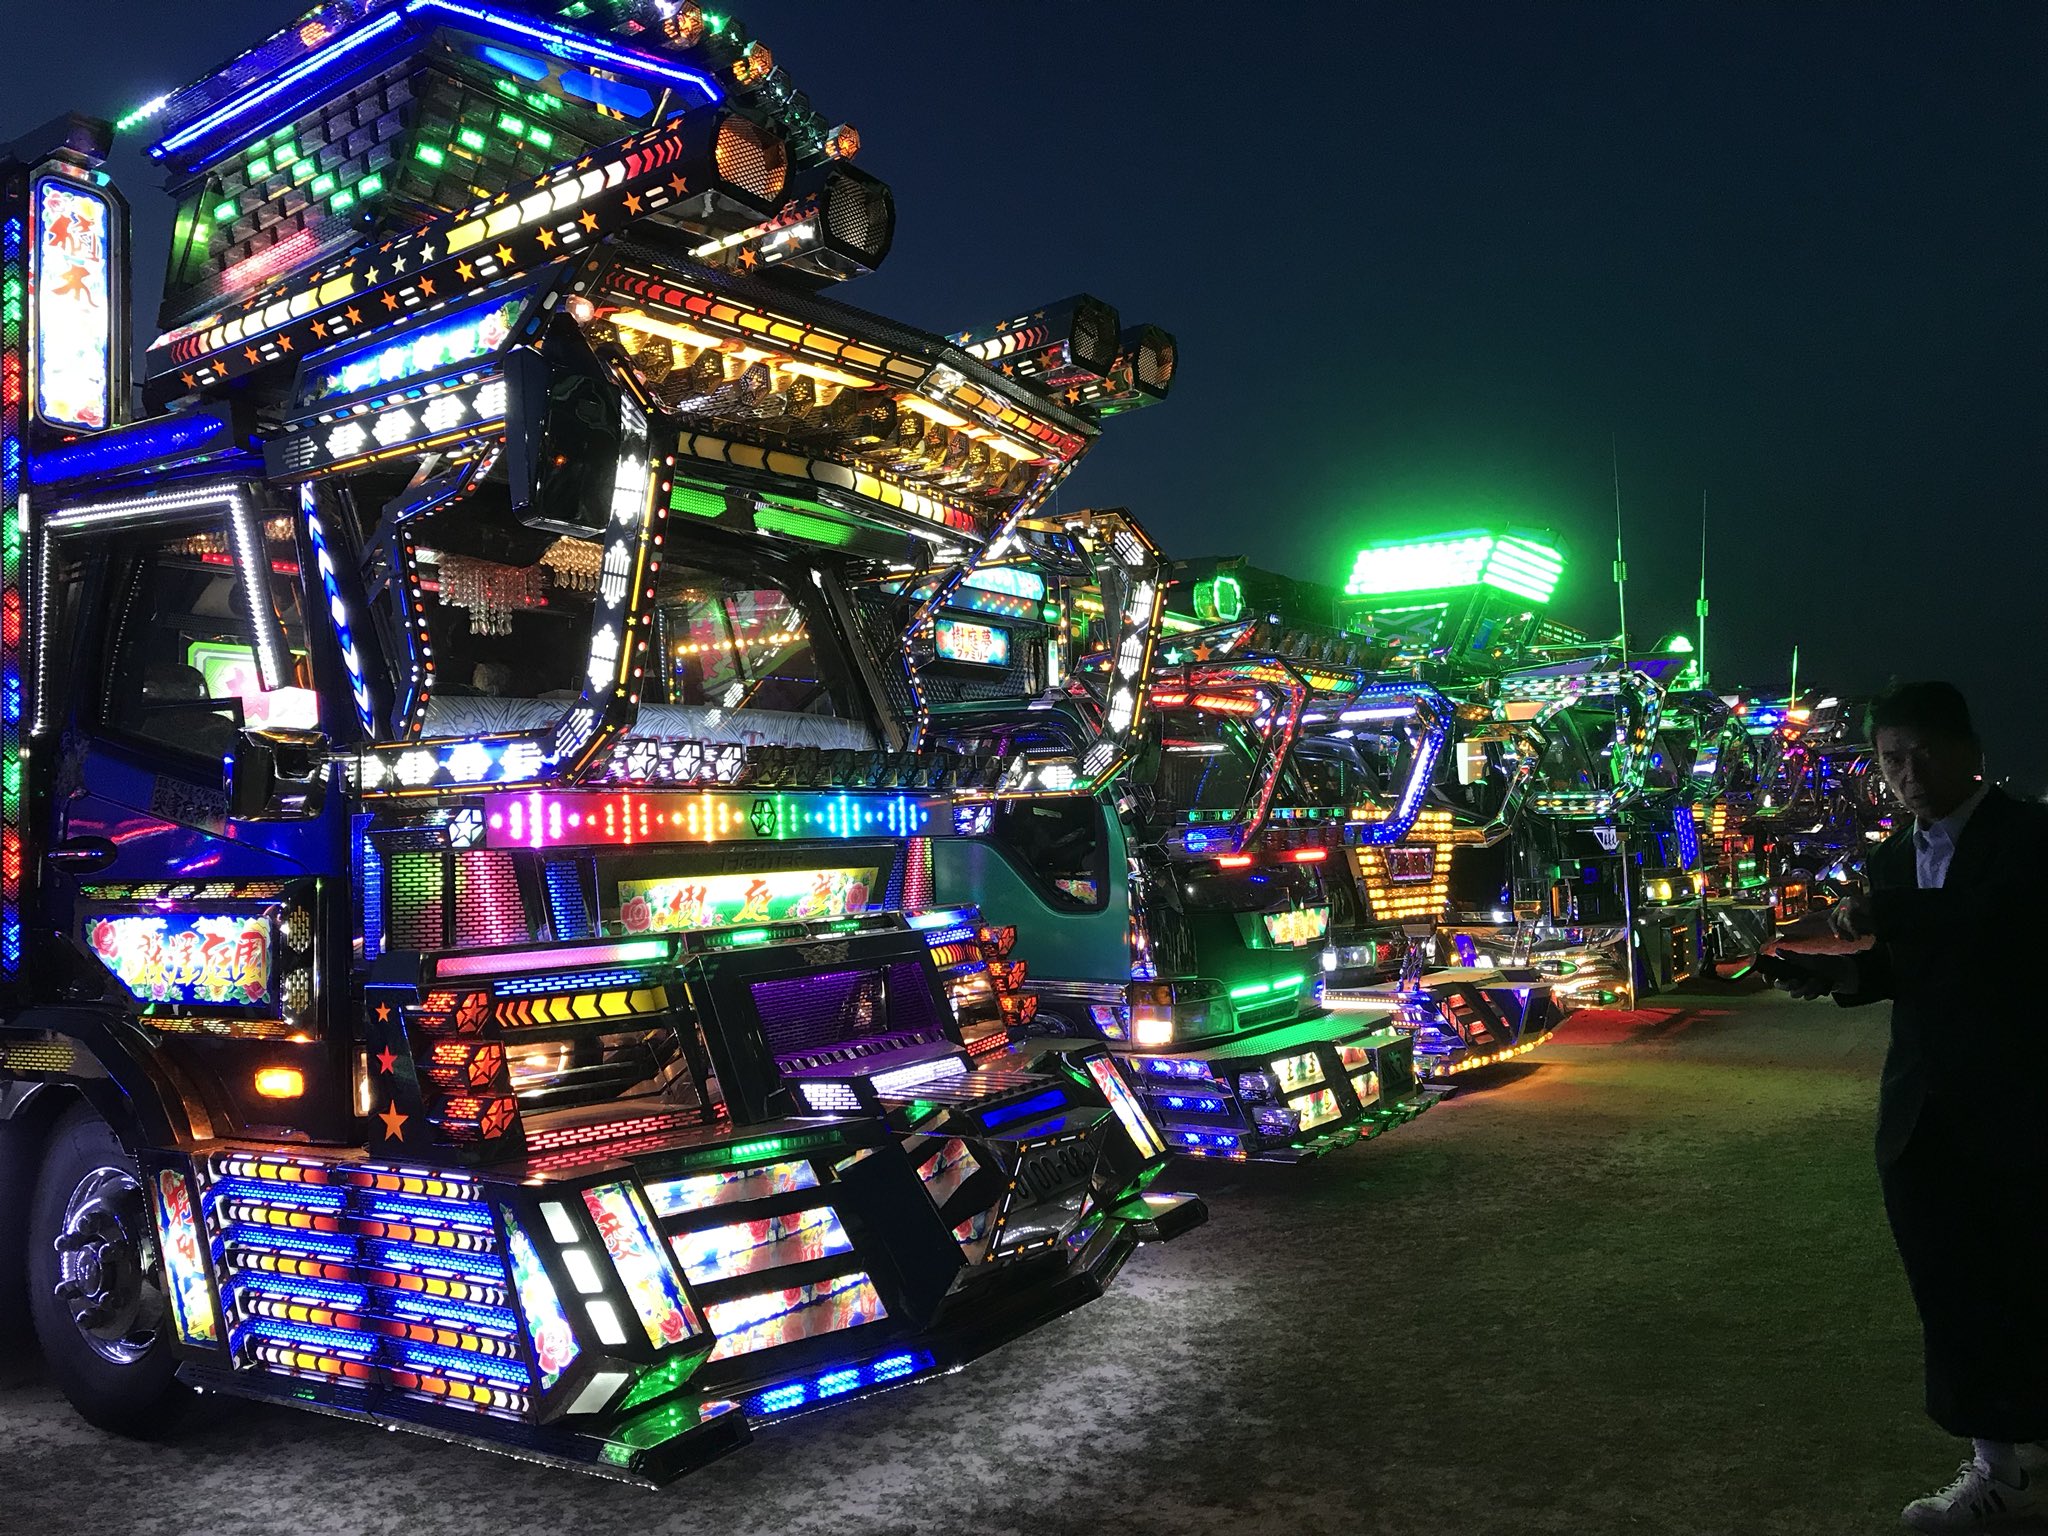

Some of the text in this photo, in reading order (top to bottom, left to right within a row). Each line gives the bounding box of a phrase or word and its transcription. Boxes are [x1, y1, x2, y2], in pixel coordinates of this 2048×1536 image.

[957, 648, 989, 661] ファミリー
